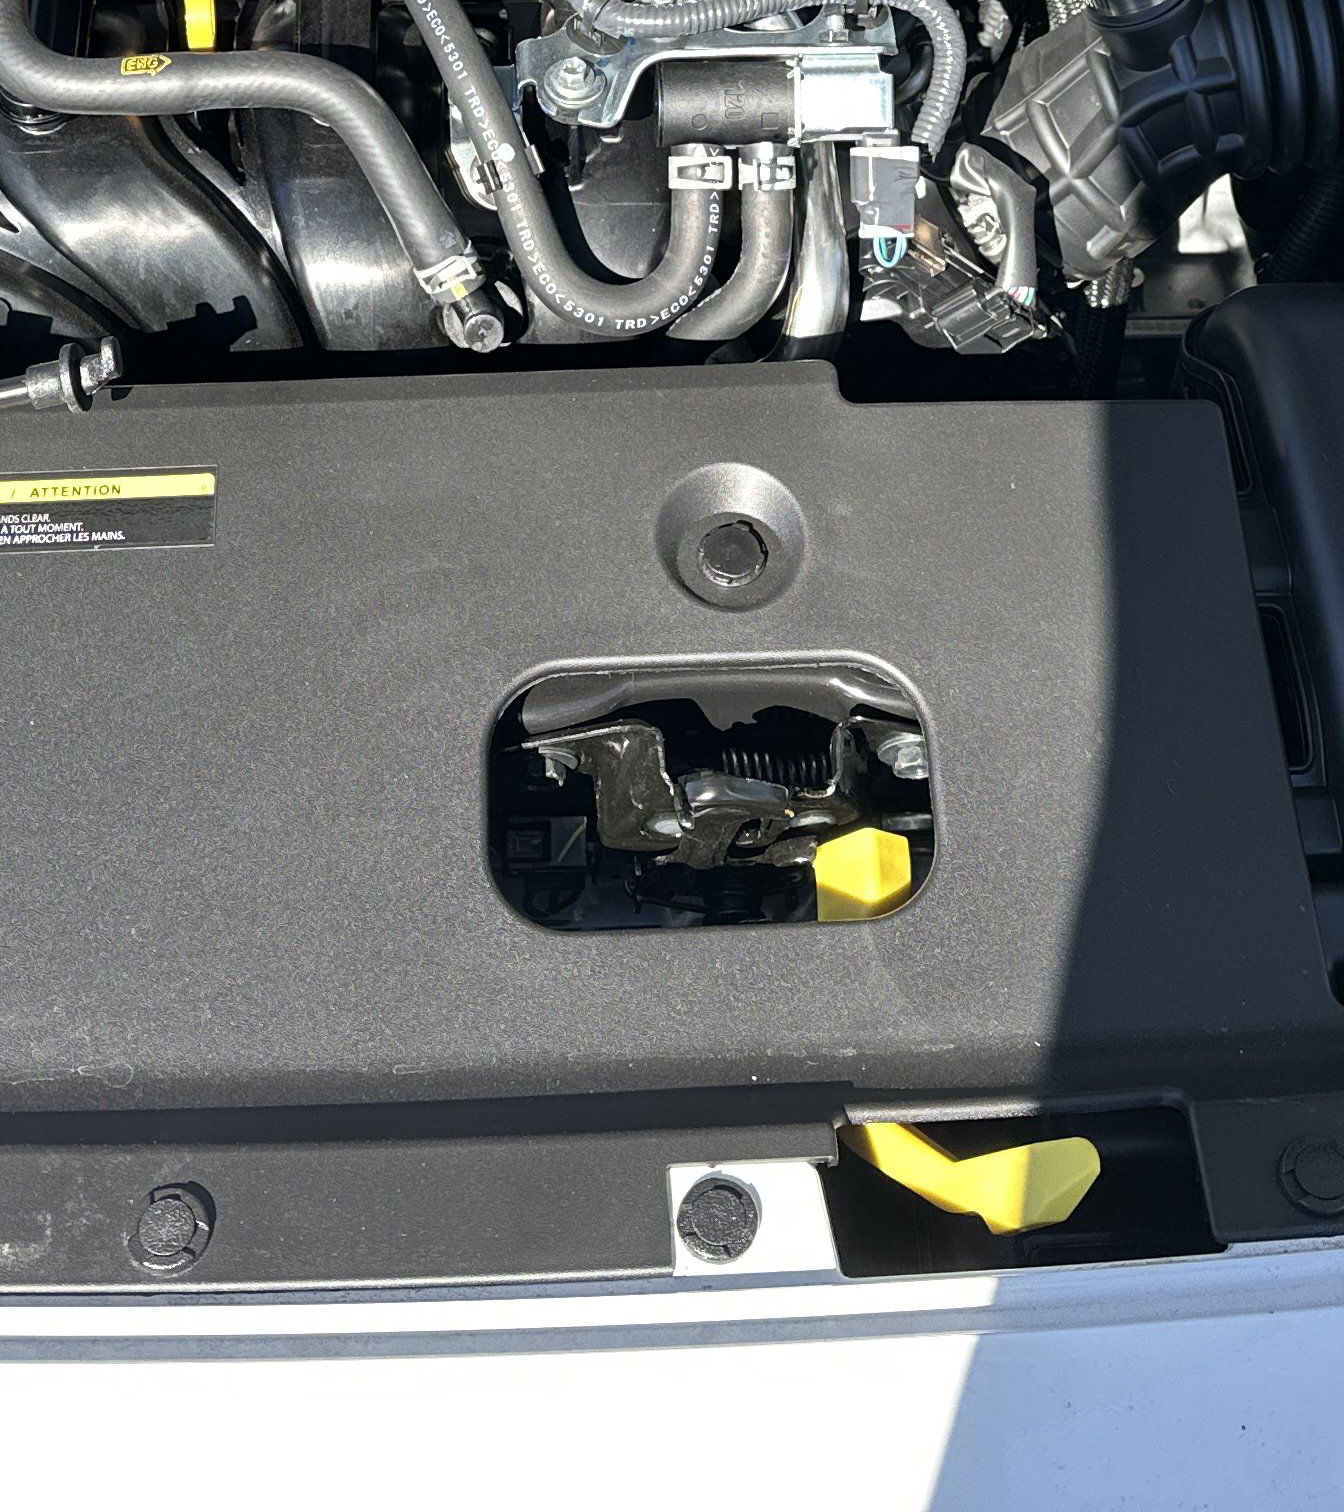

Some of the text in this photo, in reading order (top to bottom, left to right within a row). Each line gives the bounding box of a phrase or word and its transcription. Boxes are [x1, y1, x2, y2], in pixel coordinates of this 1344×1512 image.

[516, 219, 605, 326] TRD>ECO<5301
[615, 245, 714, 329] TRD>ECO<5301
[30, 484, 122, 499] ATTENTION
[21, 513, 51, 523] CLEAR.
[10, 524, 36, 534] TOUT
[37, 521, 85, 532] MOMENT.
[12, 533, 71, 544] APPROCHER
[72, 532, 90, 542] LES
